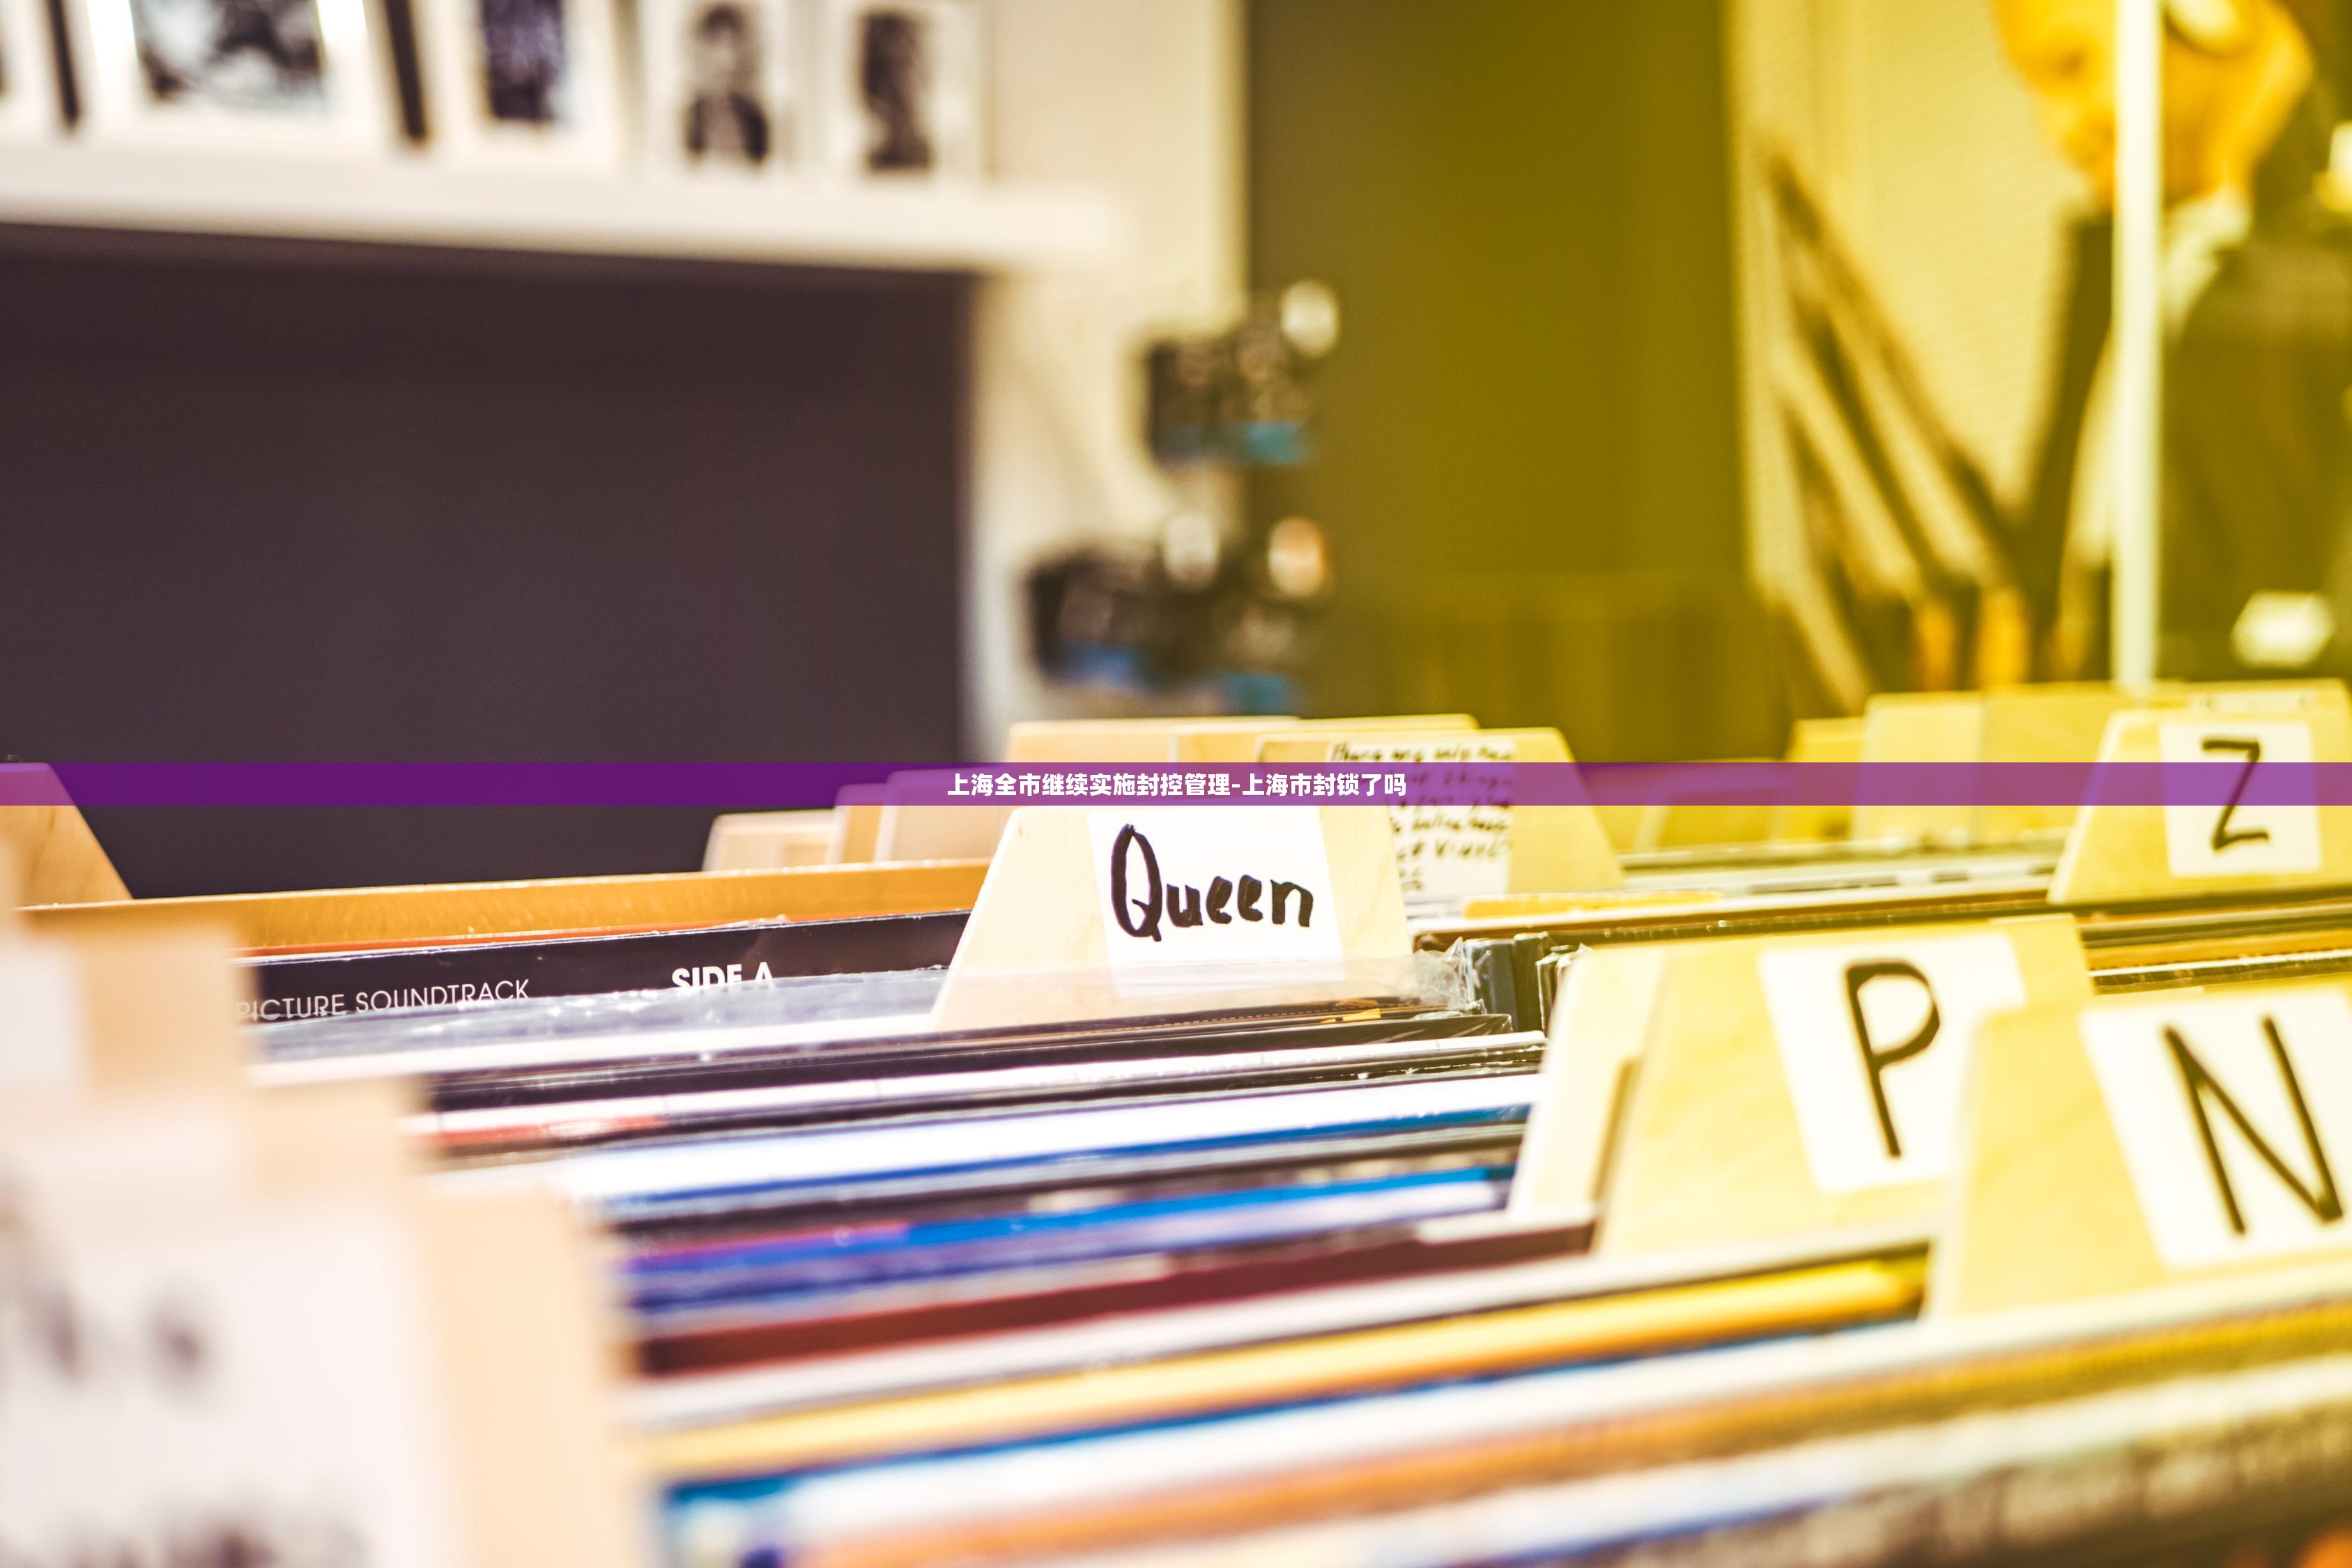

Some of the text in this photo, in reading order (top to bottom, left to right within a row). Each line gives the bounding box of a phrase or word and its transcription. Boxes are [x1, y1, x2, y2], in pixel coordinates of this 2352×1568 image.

[2201, 735, 2270, 852] Z
[1111, 823, 1314, 942] Queen
[236, 978, 530, 1023] PICTURE SOUNDTRACK
[671, 962, 774, 988] SIDE A
[1844, 959, 1941, 1159] P
[2162, 1014, 2344, 1236] N
